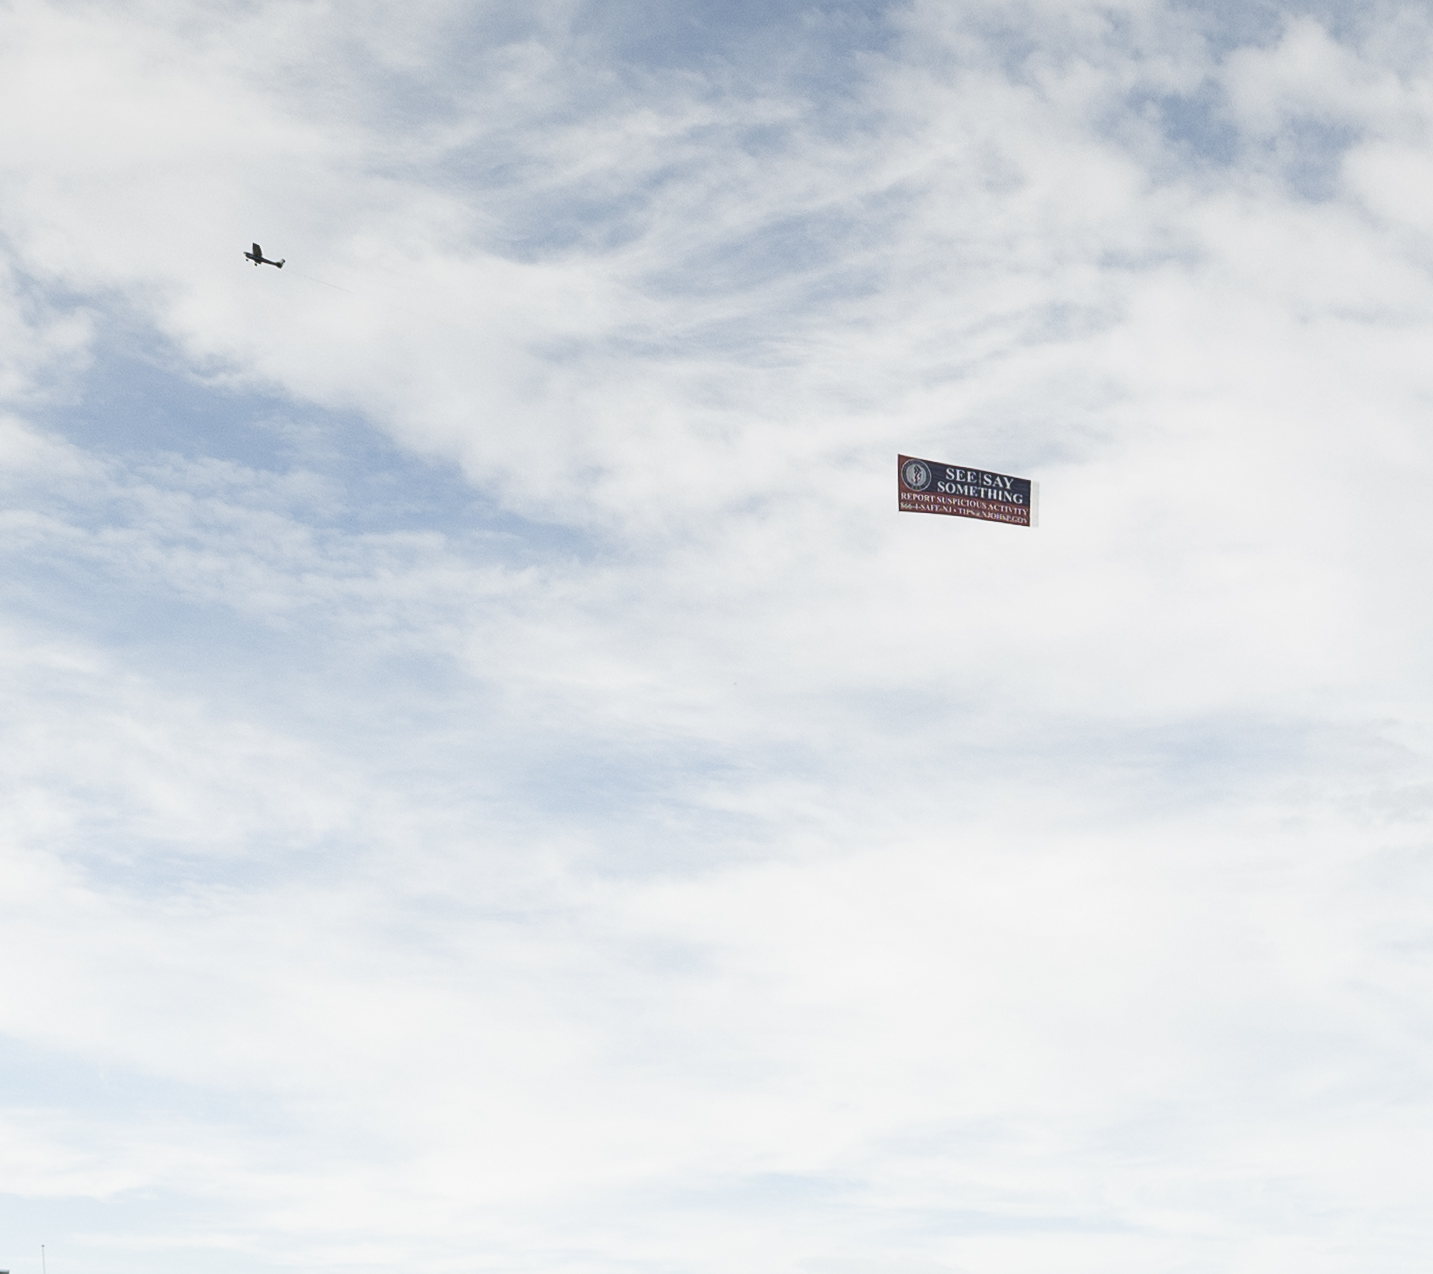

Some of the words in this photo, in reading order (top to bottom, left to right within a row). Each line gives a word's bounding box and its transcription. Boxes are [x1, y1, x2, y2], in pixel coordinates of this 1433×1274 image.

[946, 467, 977, 483] SEE
[983, 473, 1014, 490] SAY
[937, 481, 1023, 504] SOMETHING
[901, 493, 935, 502] REPORT
[936, 496, 987, 510] SUSPICIOUS
[989, 504, 1028, 516] ACTIVITY
